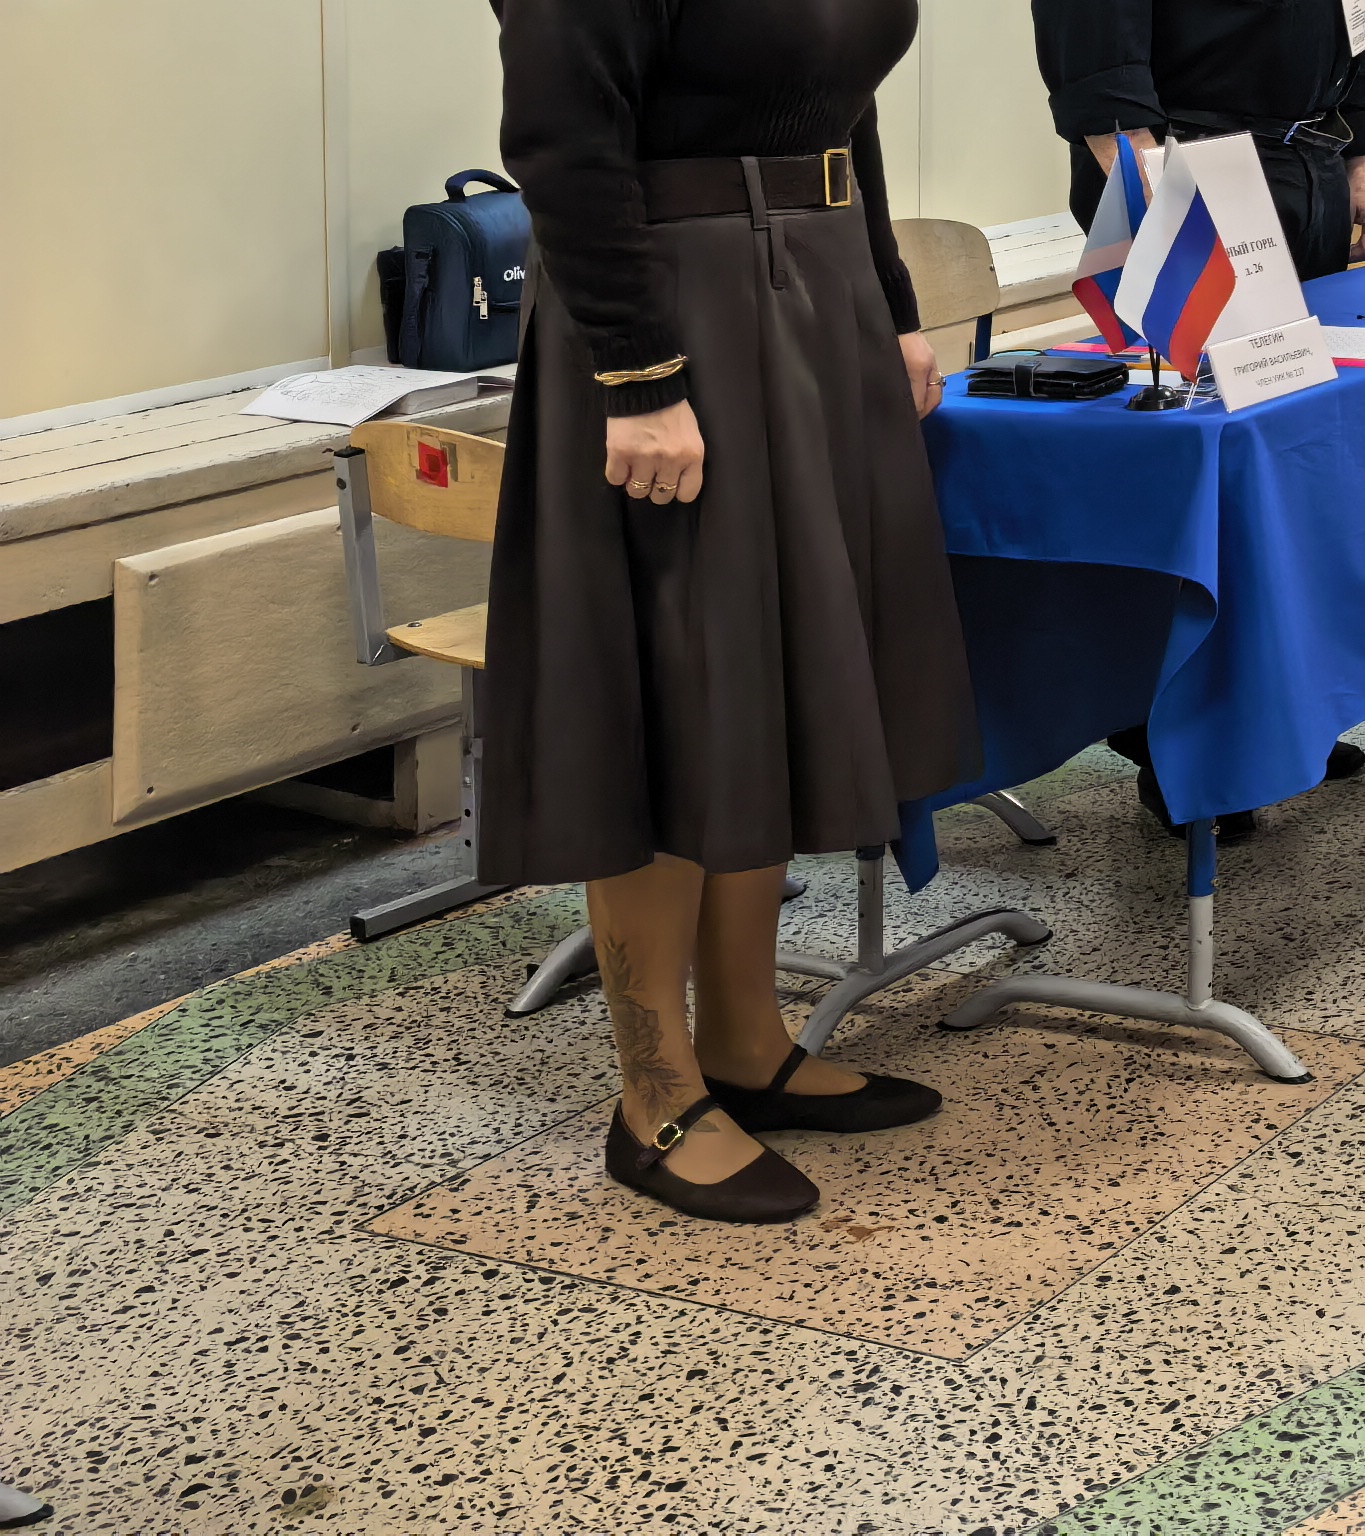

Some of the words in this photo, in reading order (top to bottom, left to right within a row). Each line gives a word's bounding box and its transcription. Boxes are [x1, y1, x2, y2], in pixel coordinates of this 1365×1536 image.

[1226, 241, 1249, 257] НЫЙ
[503, 265, 526, 282] oliv
[1253, 262, 1264, 274] 26
[1248, 331, 1285, 349] ТЕЛЕГИН
